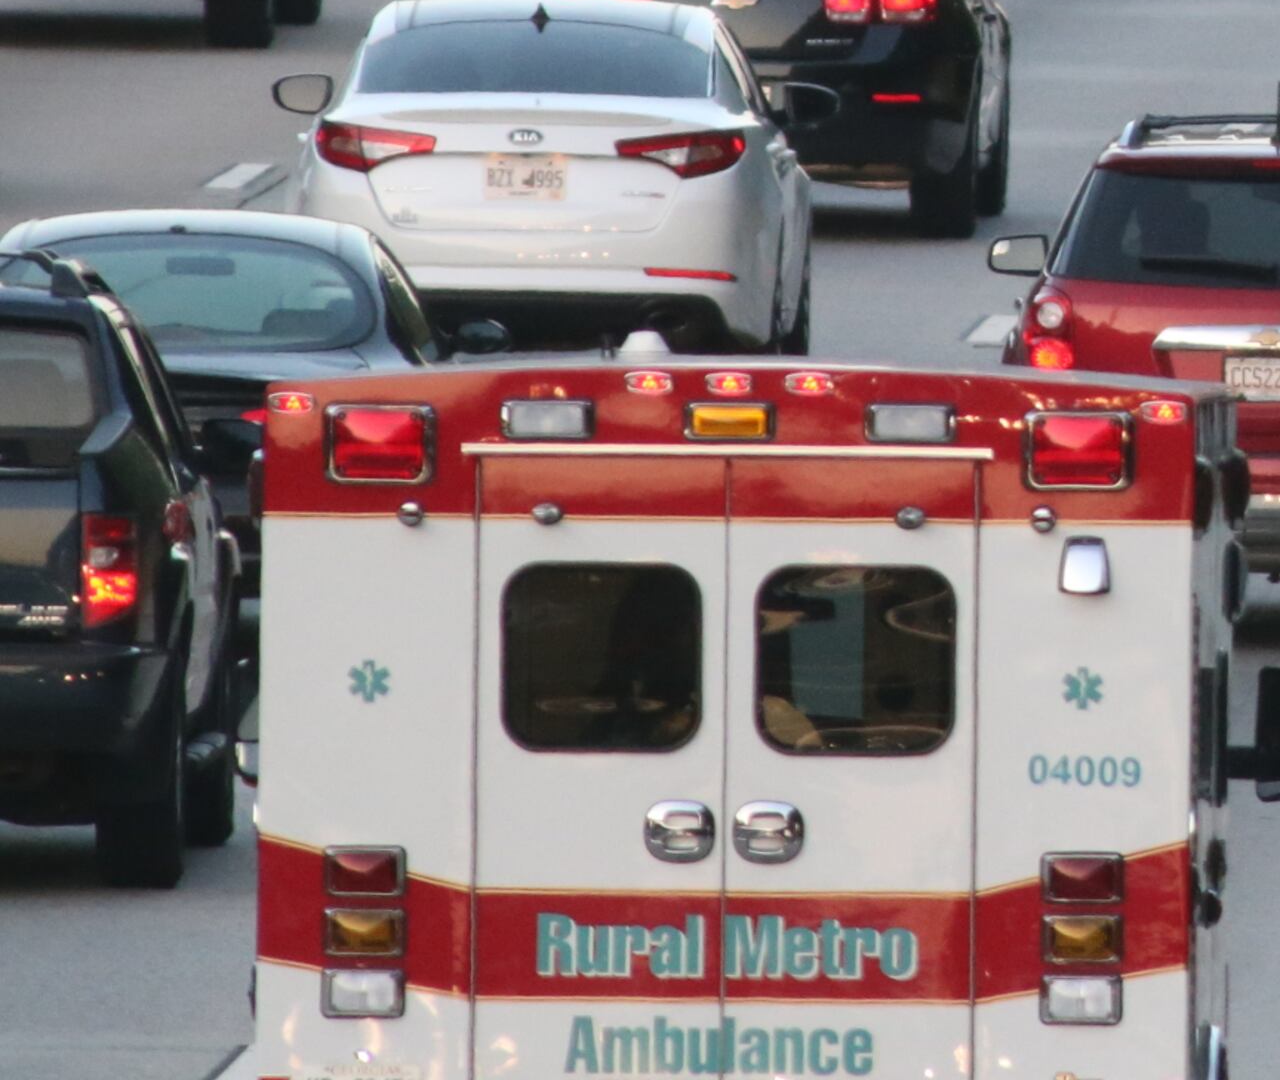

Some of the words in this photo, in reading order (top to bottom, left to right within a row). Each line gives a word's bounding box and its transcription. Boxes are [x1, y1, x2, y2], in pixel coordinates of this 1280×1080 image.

[513, 130, 538, 142] KIA
[1028, 754, 1142, 788] 04009
[536, 913, 705, 978] Rural
[723, 914, 919, 981] Metro
[564, 1015, 874, 1077] Ambulance
